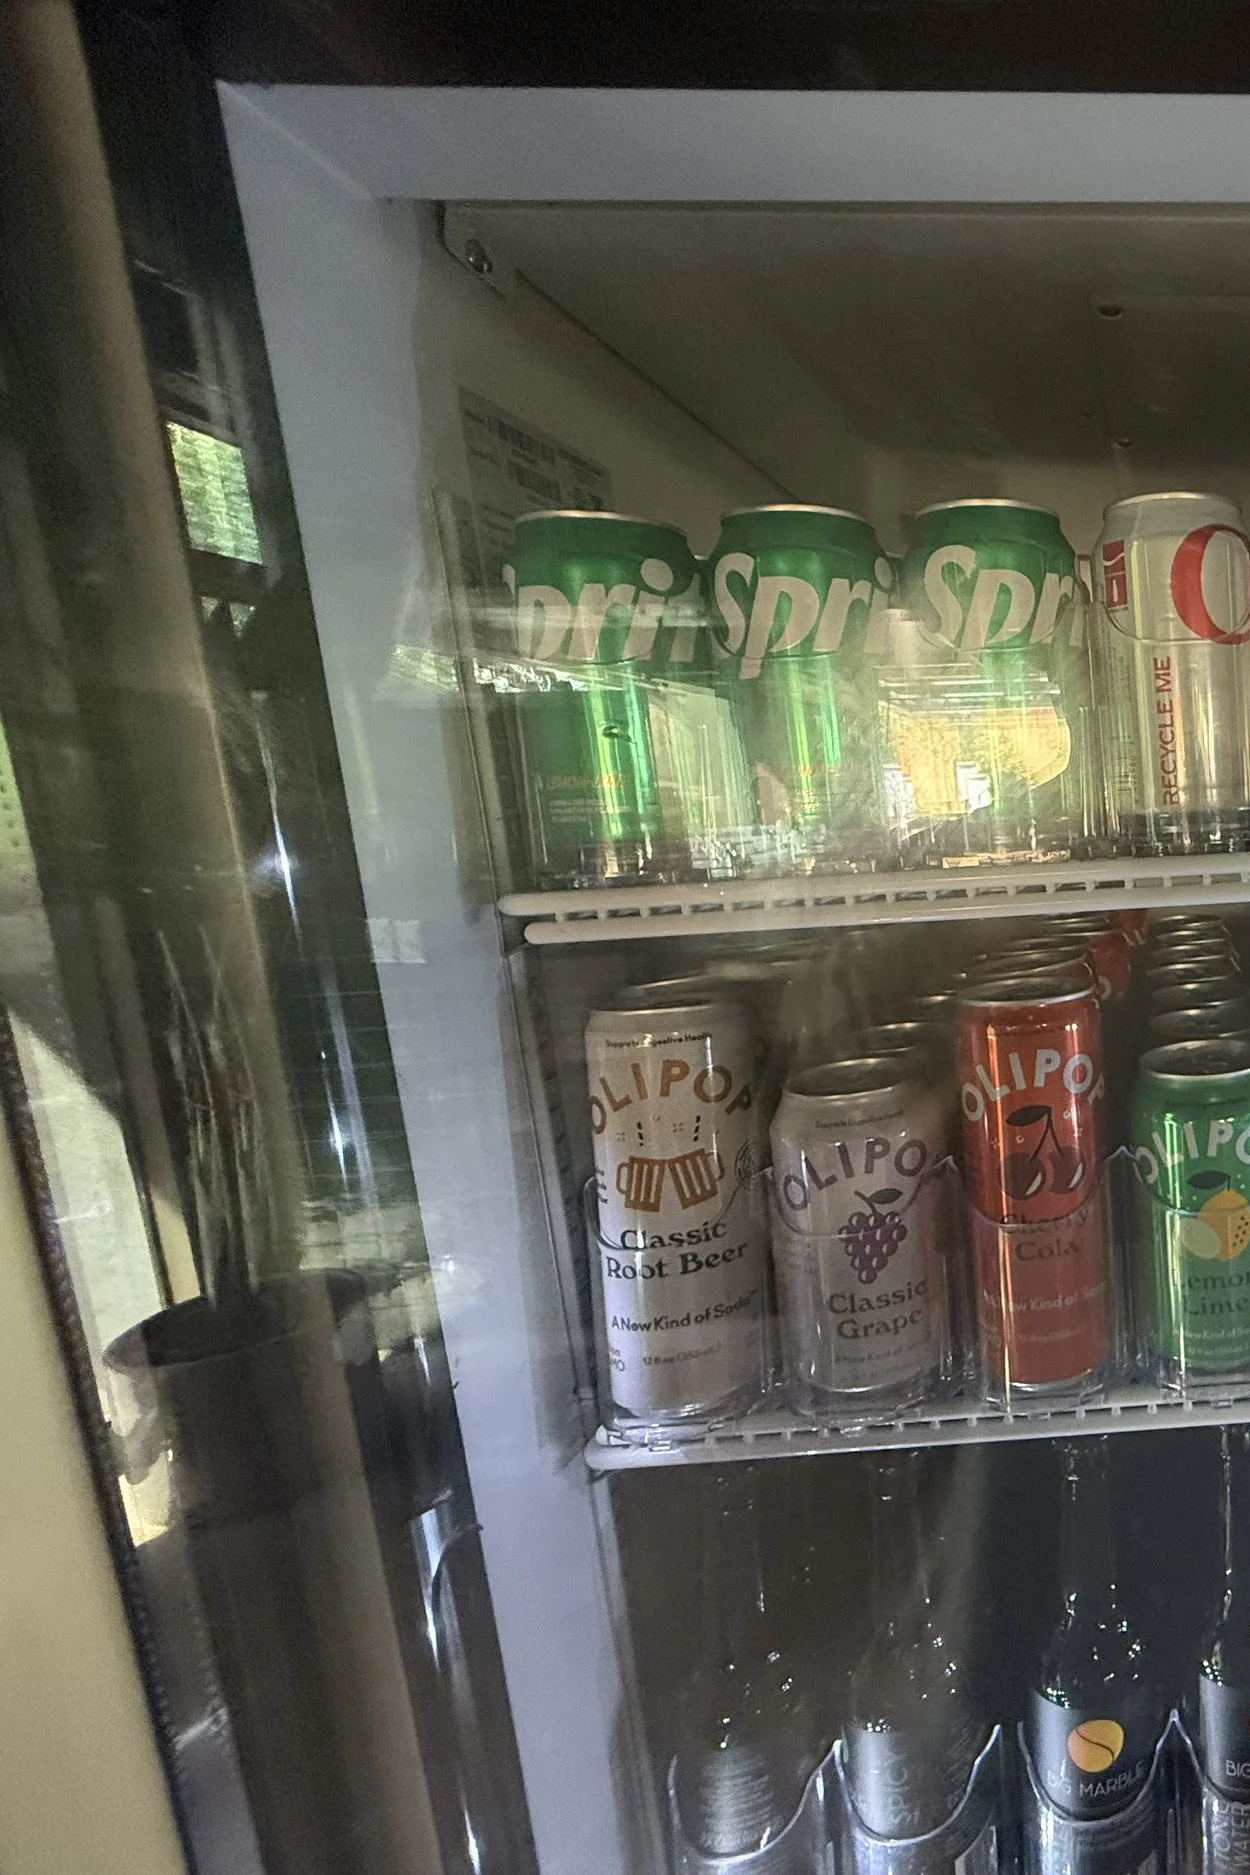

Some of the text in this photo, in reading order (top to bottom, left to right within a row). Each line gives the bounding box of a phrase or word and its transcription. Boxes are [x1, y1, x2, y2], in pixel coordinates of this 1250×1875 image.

[1153, 655, 1182, 806] RECYCLE ME
[589, 1058, 753, 1135] OLIPOP
[620, 1220, 729, 1251] Classic
[1015, 1238, 1080, 1262] Cola
[605, 1242, 749, 1281] Root Beer
[828, 1280, 928, 1315] Classic
[611, 1315, 621, 1331] A
[621, 1317, 651, 1332] New
[653, 1312, 692, 1332] Kind
[694, 1306, 712, 1325] of
[836, 1308, 923, 1340] Grape
[1078, 1759, 1146, 1799] MARBLE
